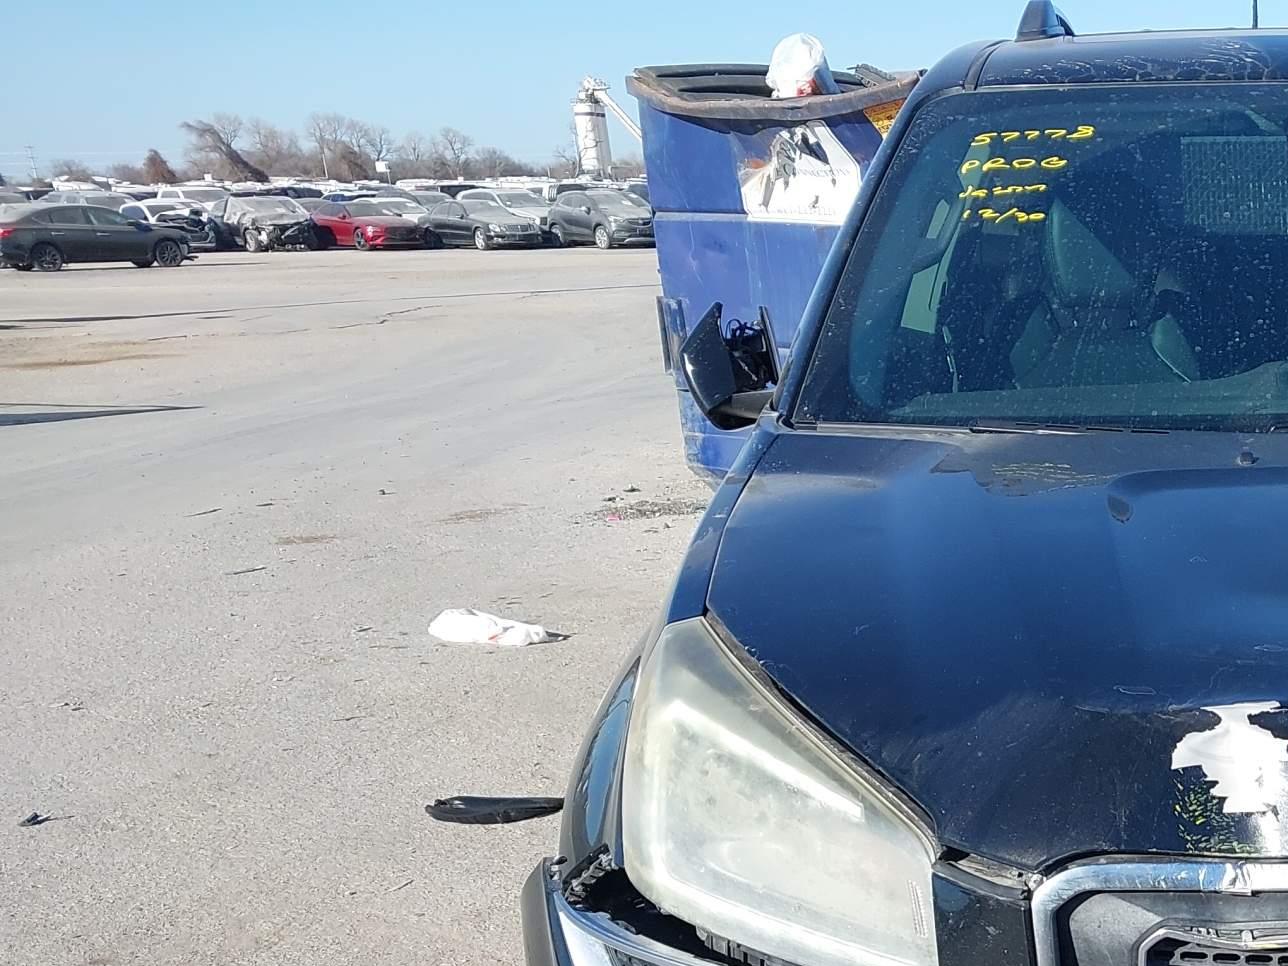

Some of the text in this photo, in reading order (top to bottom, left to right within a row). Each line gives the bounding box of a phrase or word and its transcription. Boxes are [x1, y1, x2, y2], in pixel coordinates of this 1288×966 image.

[971, 124, 1096, 146] 57778
[960, 156, 1069, 174] PROG
[962, 207, 1047, 224] 12/30
